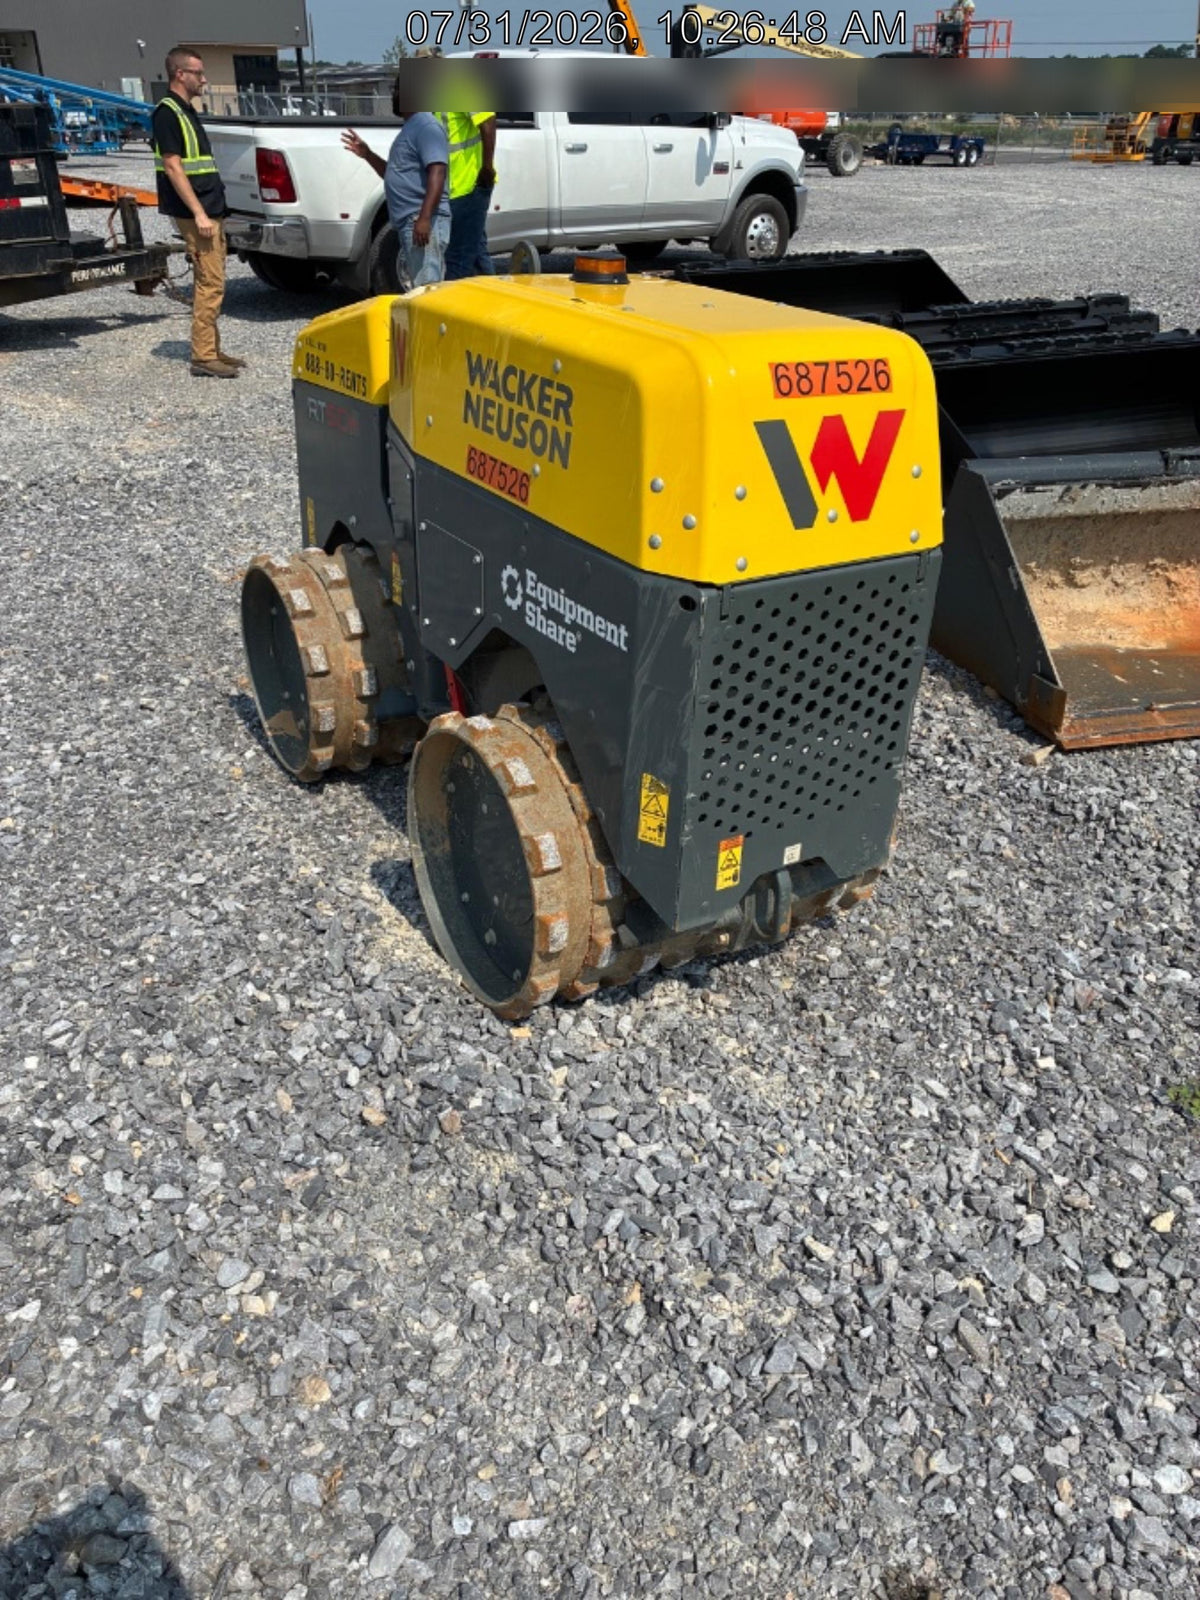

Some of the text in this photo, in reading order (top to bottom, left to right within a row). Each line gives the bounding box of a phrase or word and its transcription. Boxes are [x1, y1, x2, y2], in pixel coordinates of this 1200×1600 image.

[464, 349, 575, 427] WACKER
[773, 358, 892, 397] 687526
[463, 389, 572, 470] NEUSON
[466, 446, 531, 503] 687526
[525, 567, 629, 652] Equipment
